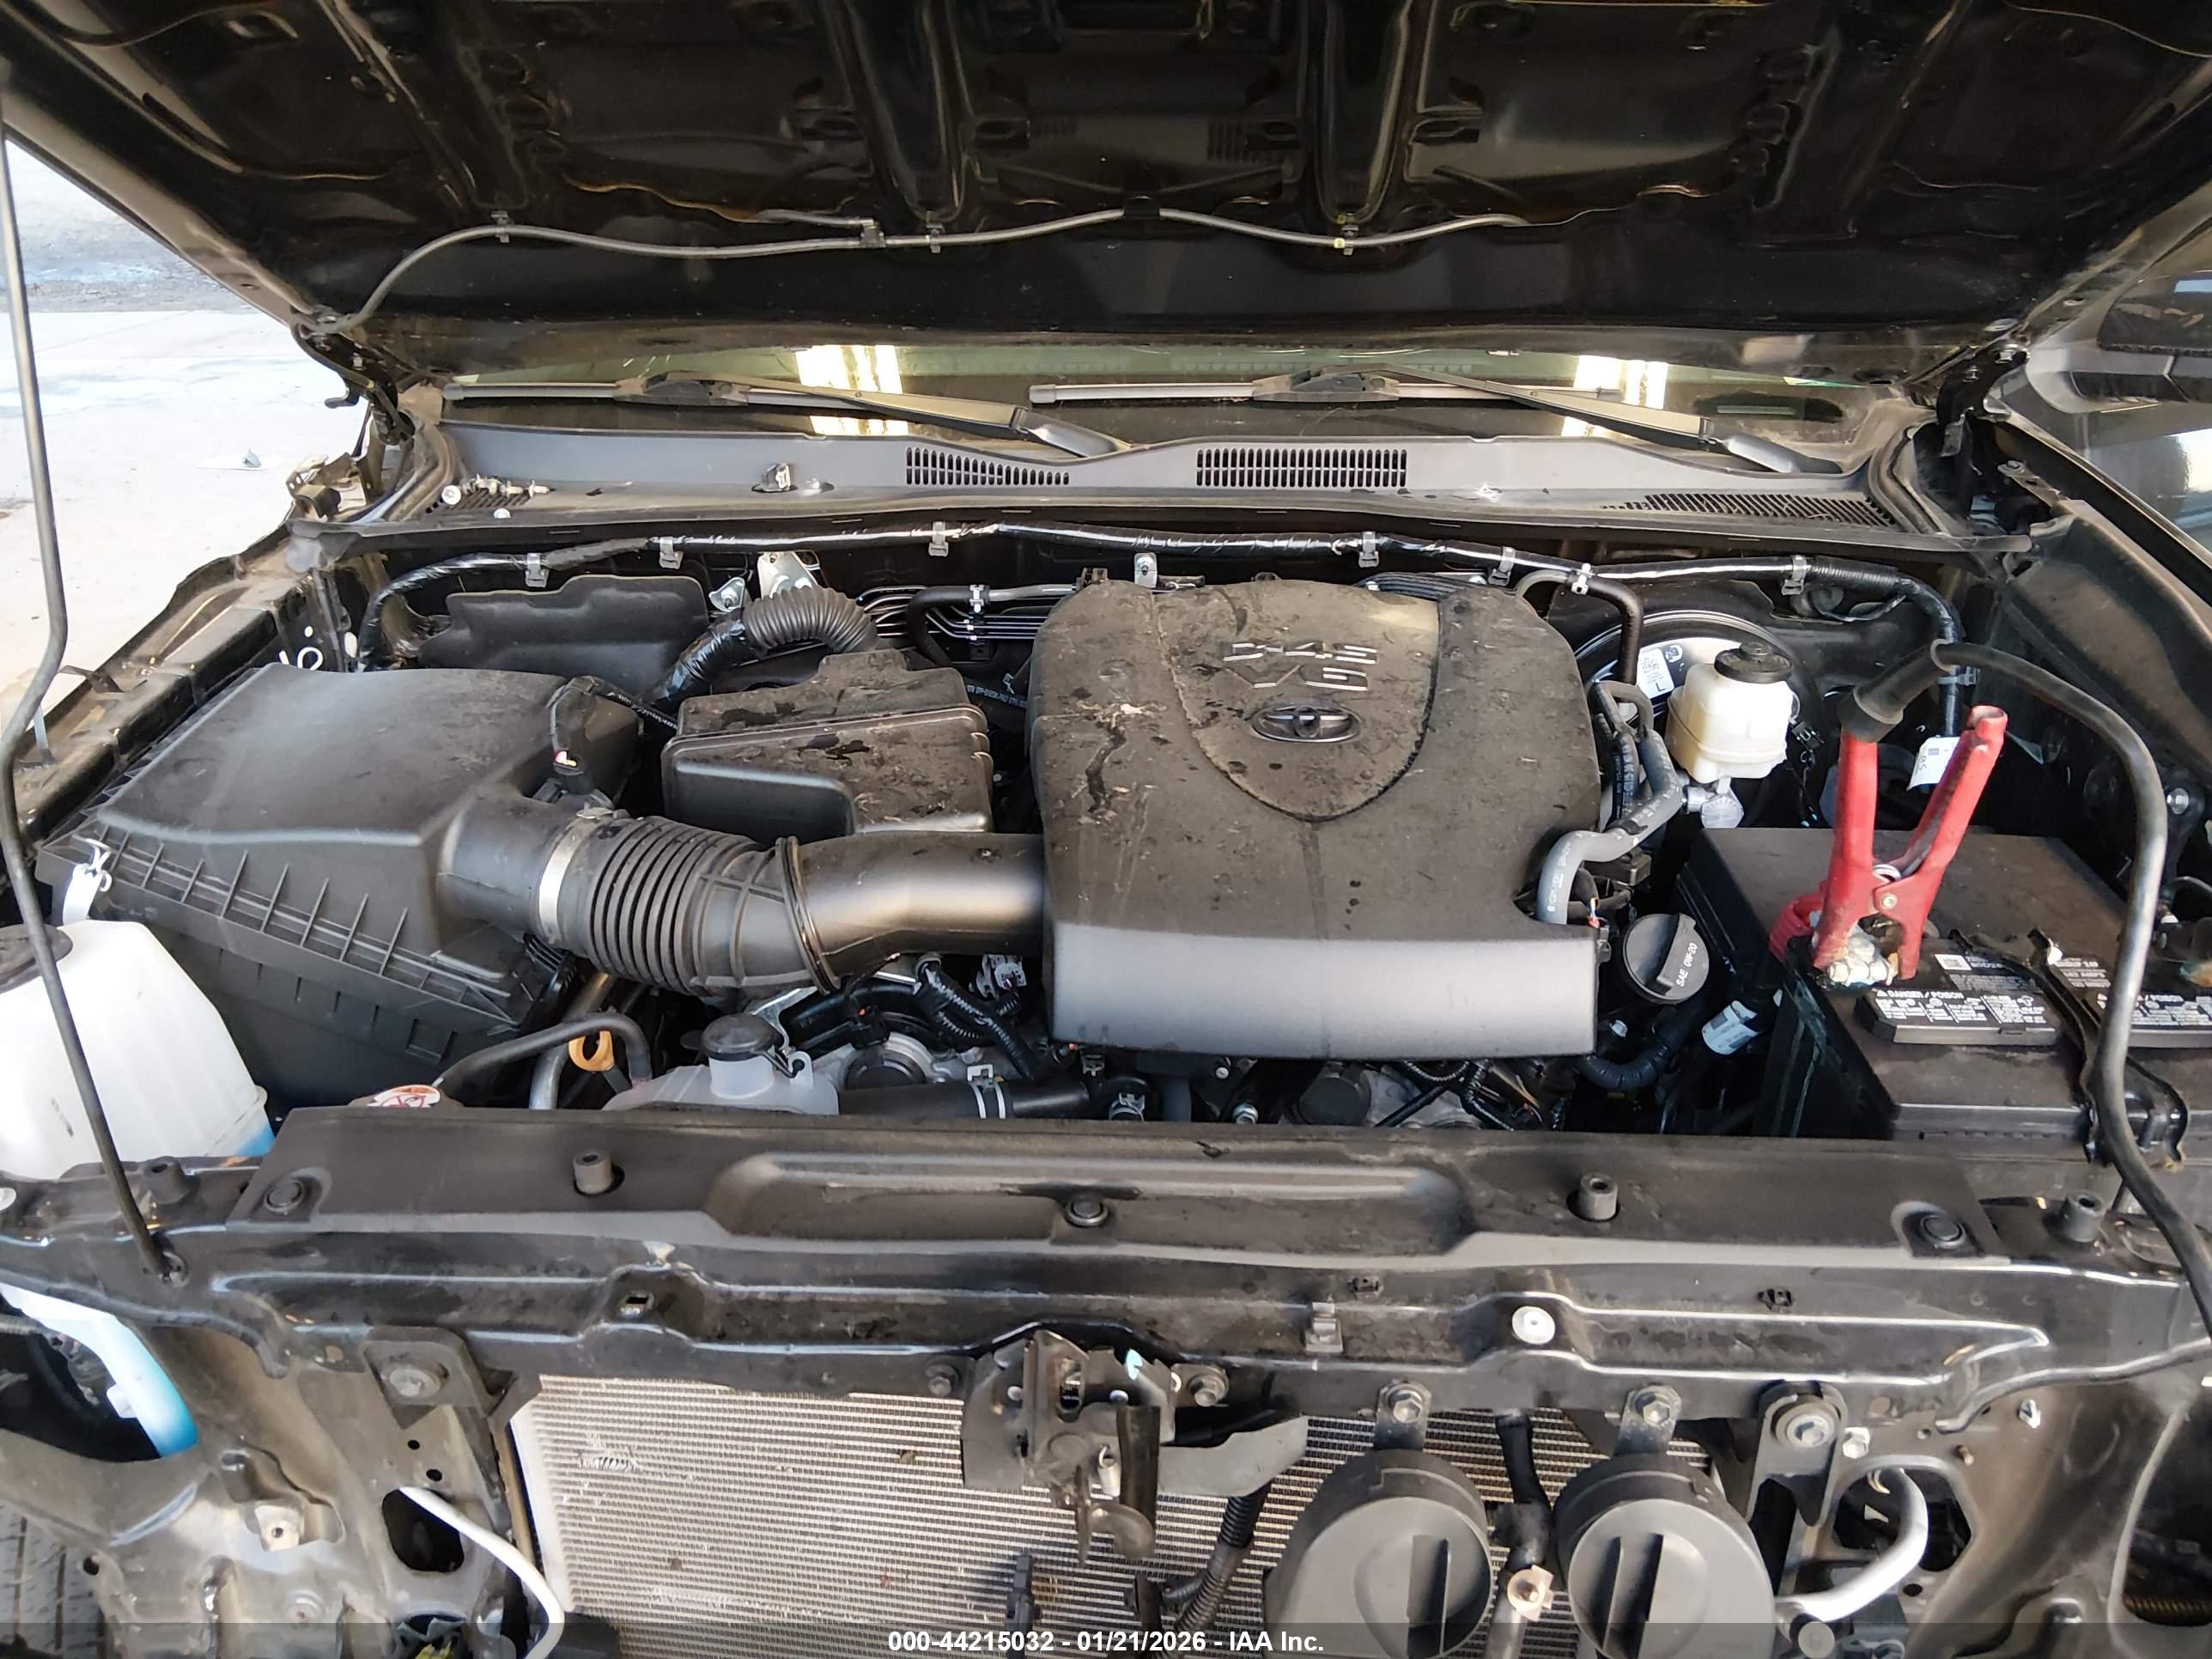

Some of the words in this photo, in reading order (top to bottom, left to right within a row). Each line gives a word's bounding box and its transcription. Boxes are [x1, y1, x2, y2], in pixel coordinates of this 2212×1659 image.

[1223, 664, 1370, 691] V6
[1675, 968, 1689, 988] SAE
[1683, 941, 1698, 968] 0W-20
